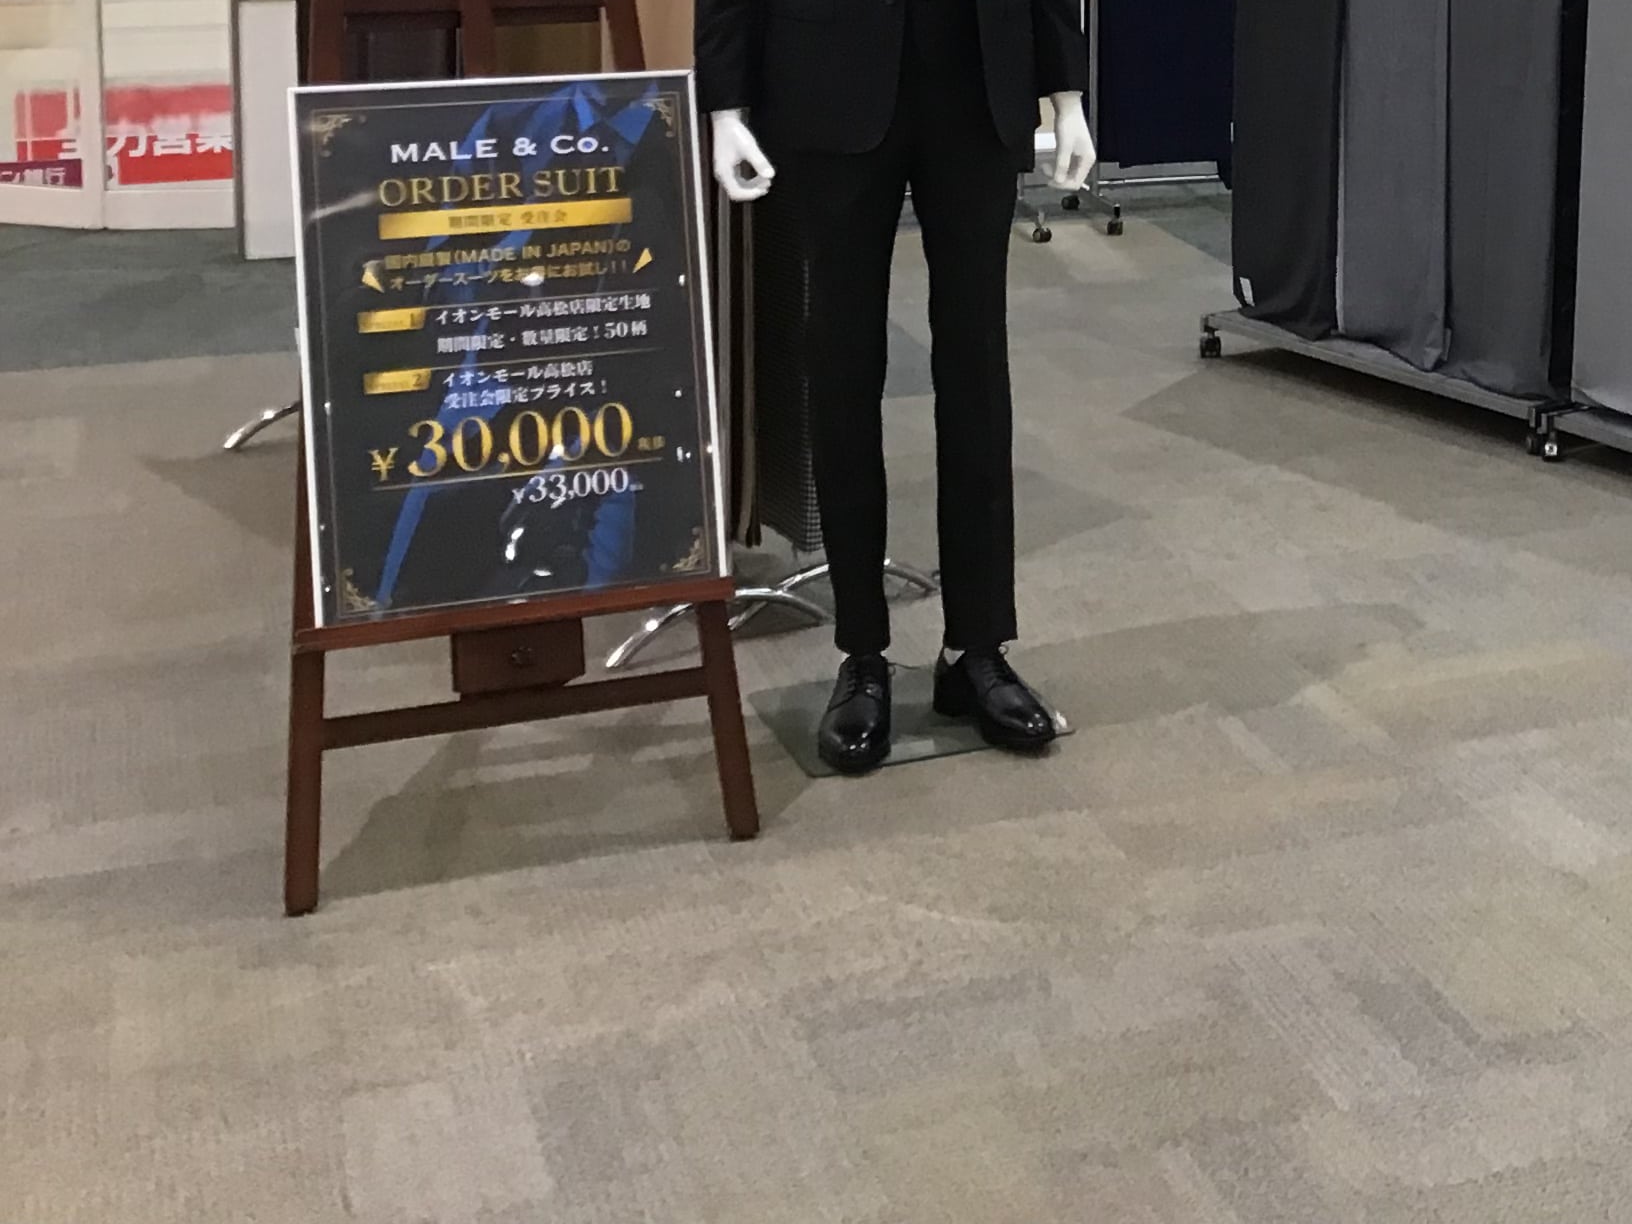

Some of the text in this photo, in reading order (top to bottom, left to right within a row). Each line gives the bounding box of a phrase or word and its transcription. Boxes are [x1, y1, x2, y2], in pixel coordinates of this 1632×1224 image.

[390, 138, 499, 164] MALE
[512, 136, 538, 157] &
[378, 166, 626, 207] ORDER SUIT
[442, 359, 594, 386] イオンモール高松店
